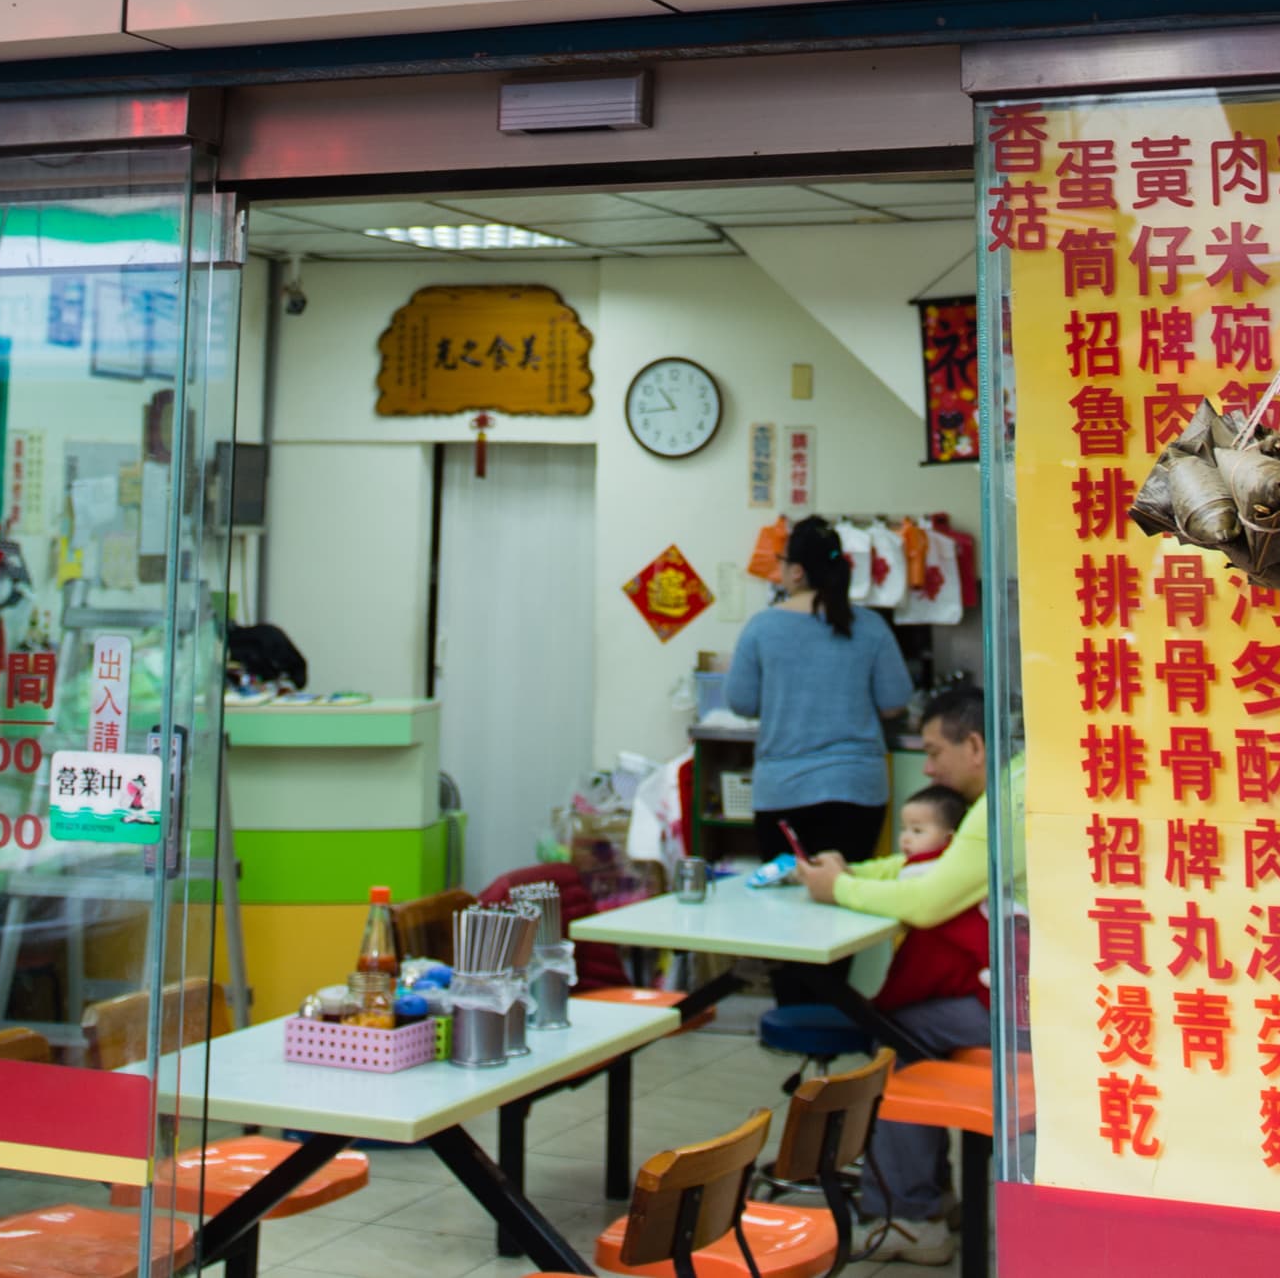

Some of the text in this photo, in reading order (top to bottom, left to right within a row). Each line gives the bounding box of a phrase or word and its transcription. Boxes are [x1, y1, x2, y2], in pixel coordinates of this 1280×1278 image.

[988, 102, 1048, 253] 香菇
[56, 766, 123, 799] 營業中
